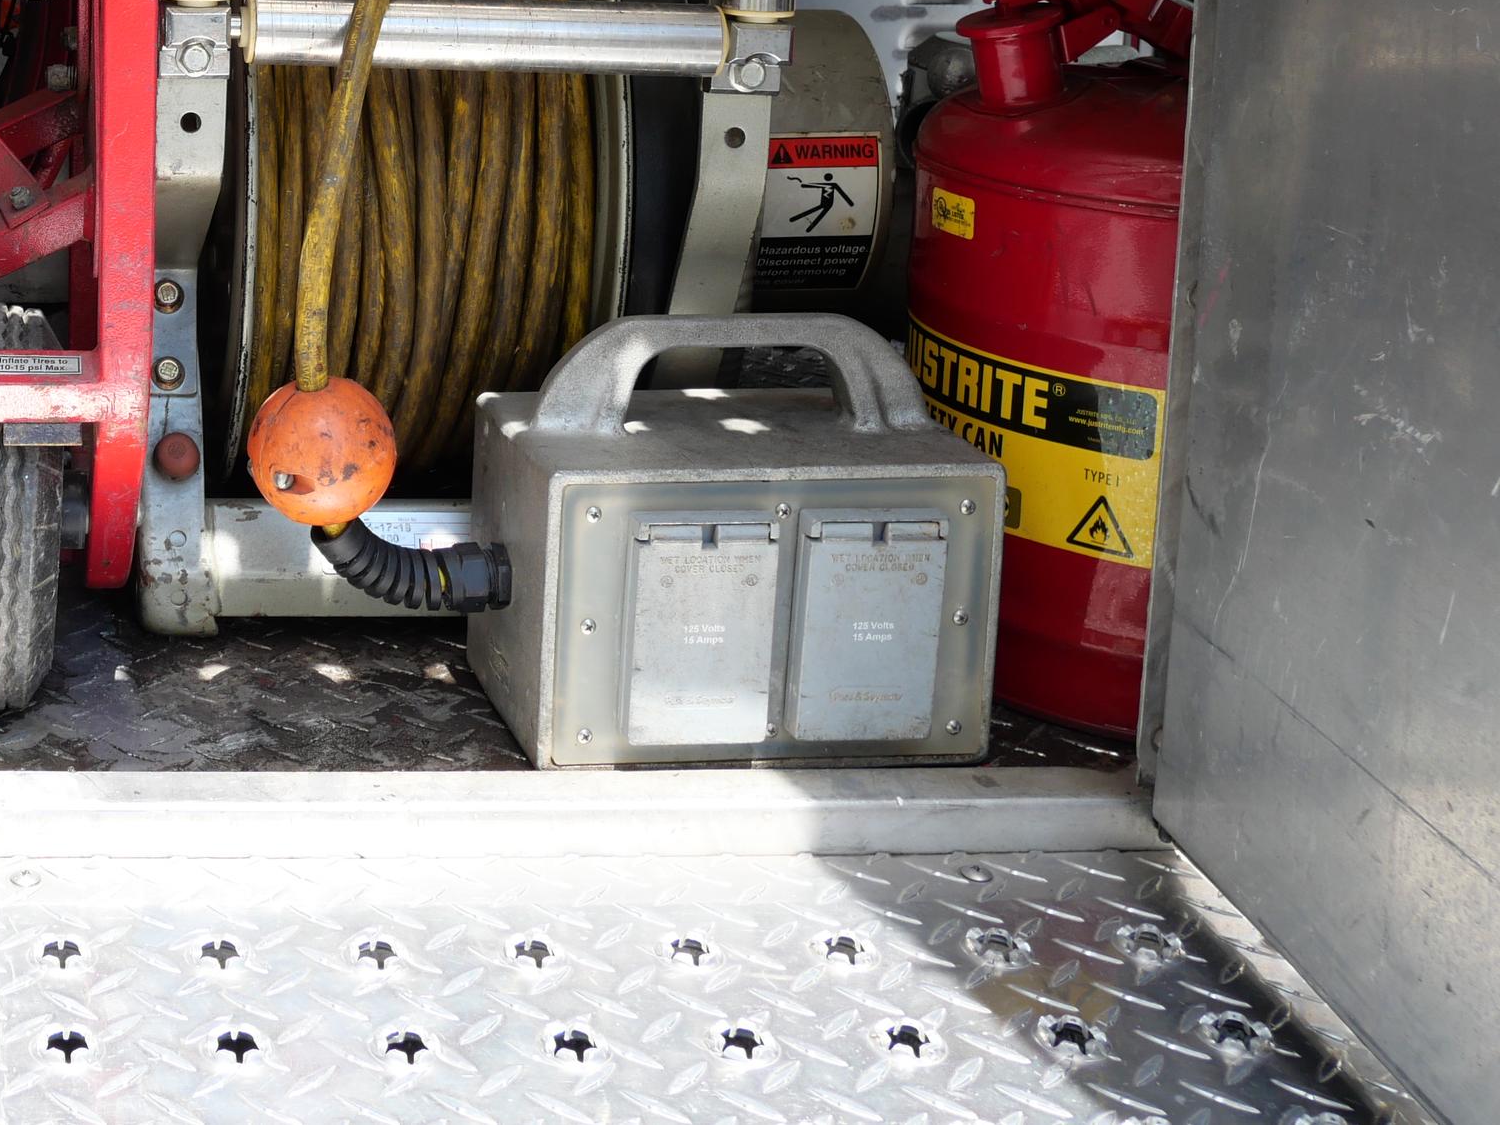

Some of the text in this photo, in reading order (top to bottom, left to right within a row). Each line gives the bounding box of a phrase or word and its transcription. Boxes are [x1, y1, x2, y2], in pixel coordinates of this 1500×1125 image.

[795, 143, 875, 160] WARNING
[760, 245, 869, 255] Hazardous voltage.
[757, 257, 860, 266] Disconnect power
[793, 267, 847, 277] removing
[32, 357, 56, 365] Tires
[27, 364, 42, 373] psi
[1068, 415, 1145, 436] www.justritemfg.com
[962, 422, 1003, 458] CAN
[1084, 468, 1112, 486] TYPE
[660, 555, 761, 565] WET LOCATION WHEN
[831, 553, 931, 563] WET LOCATION WHEN
[674, 564, 745, 574] COVER CLOSED
[845, 562, 915, 572] COVER CLOSED
[683, 624, 726, 634] 125 Volts
[852, 621, 894, 631] 125 Volts
[683, 635, 724, 646] 15 Amps
[852, 632, 893, 643] 15 Amps
